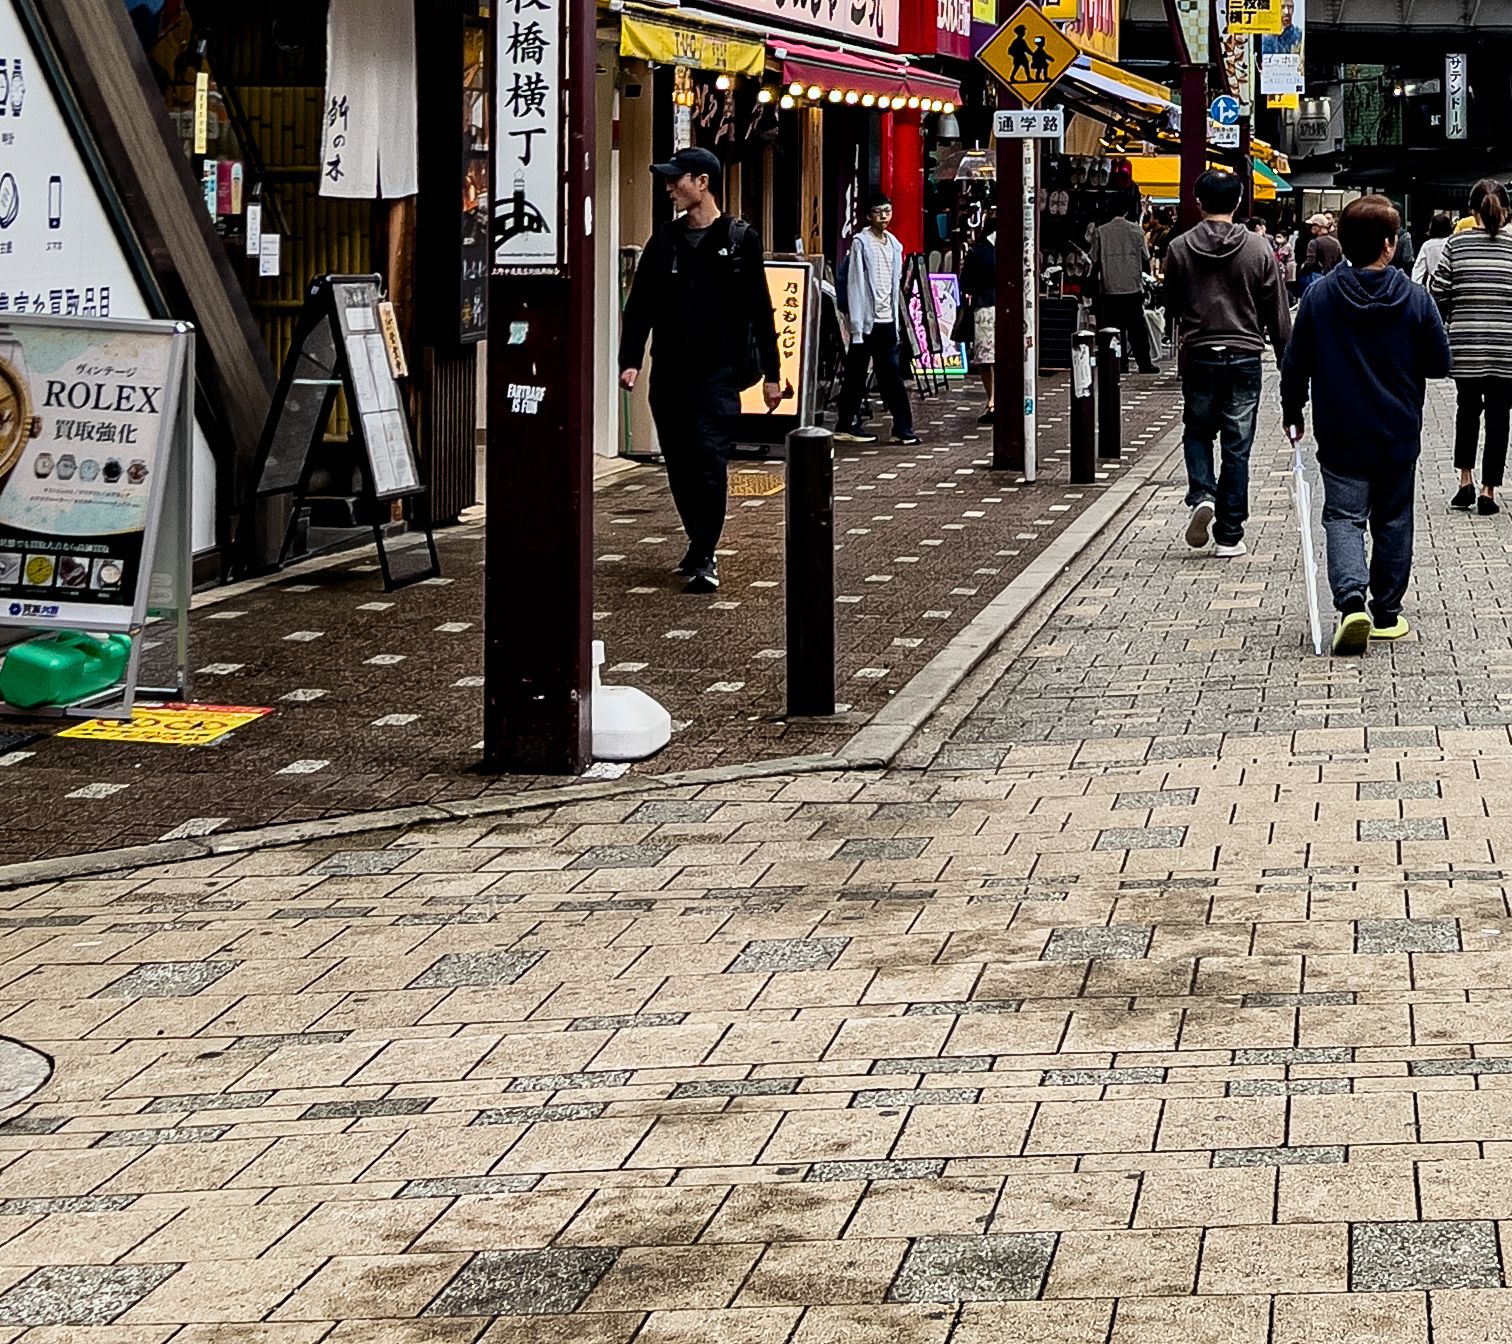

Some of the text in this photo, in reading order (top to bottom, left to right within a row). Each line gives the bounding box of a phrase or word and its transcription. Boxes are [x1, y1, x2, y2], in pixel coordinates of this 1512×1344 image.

[1229, 10, 1257, 25] 横丁
[1449, 58, 1463, 136] サテンドール
[998, 115, 1059, 133] 通学路
[75, 363, 138, 379] ヴィンテージ
[42, 380, 162, 415] ROLEX
[53, 418, 139, 445] 買取強化
